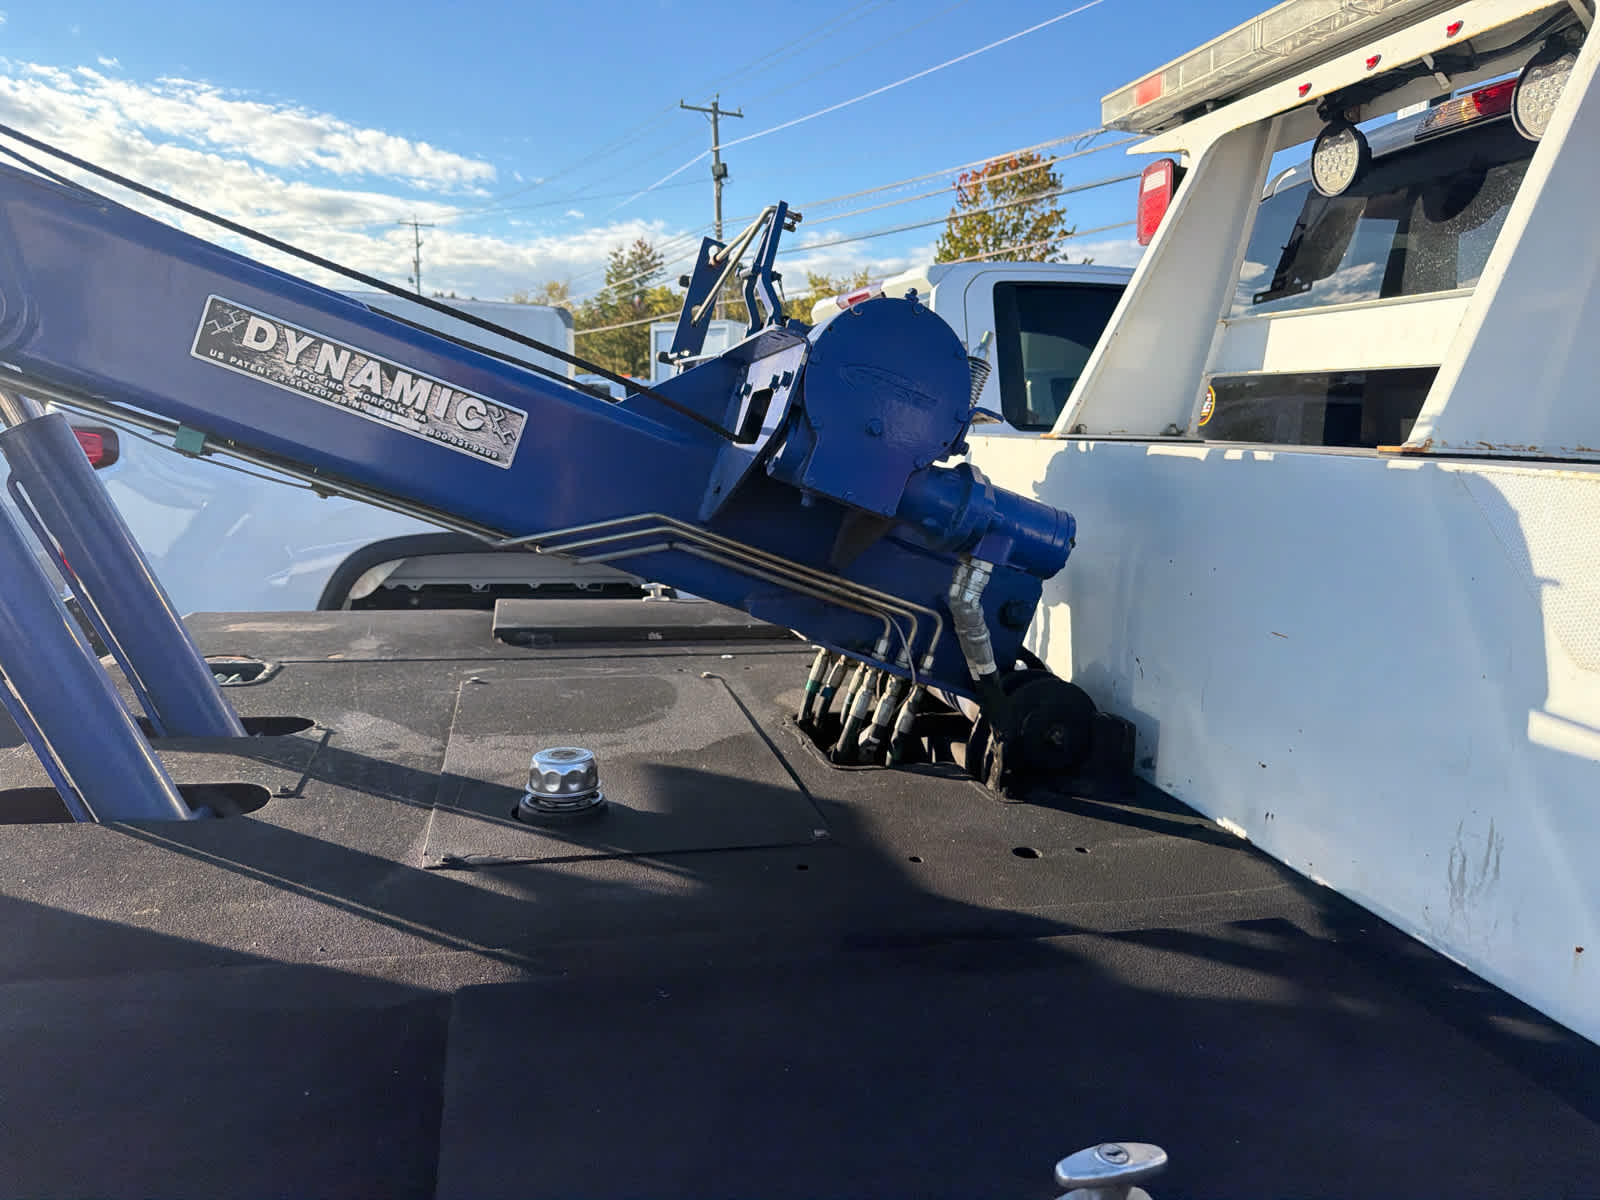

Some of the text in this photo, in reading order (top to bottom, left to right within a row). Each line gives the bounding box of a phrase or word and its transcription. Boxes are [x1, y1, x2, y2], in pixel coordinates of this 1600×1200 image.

[209, 348, 225, 361] US
[230, 356, 273, 378] PATENT
[241, 315, 488, 431] DYNAMIC
[324, 379, 346, 393] INC.
[355, 391, 409, 417] NORFOLK,
[414, 412, 427, 422] VA
